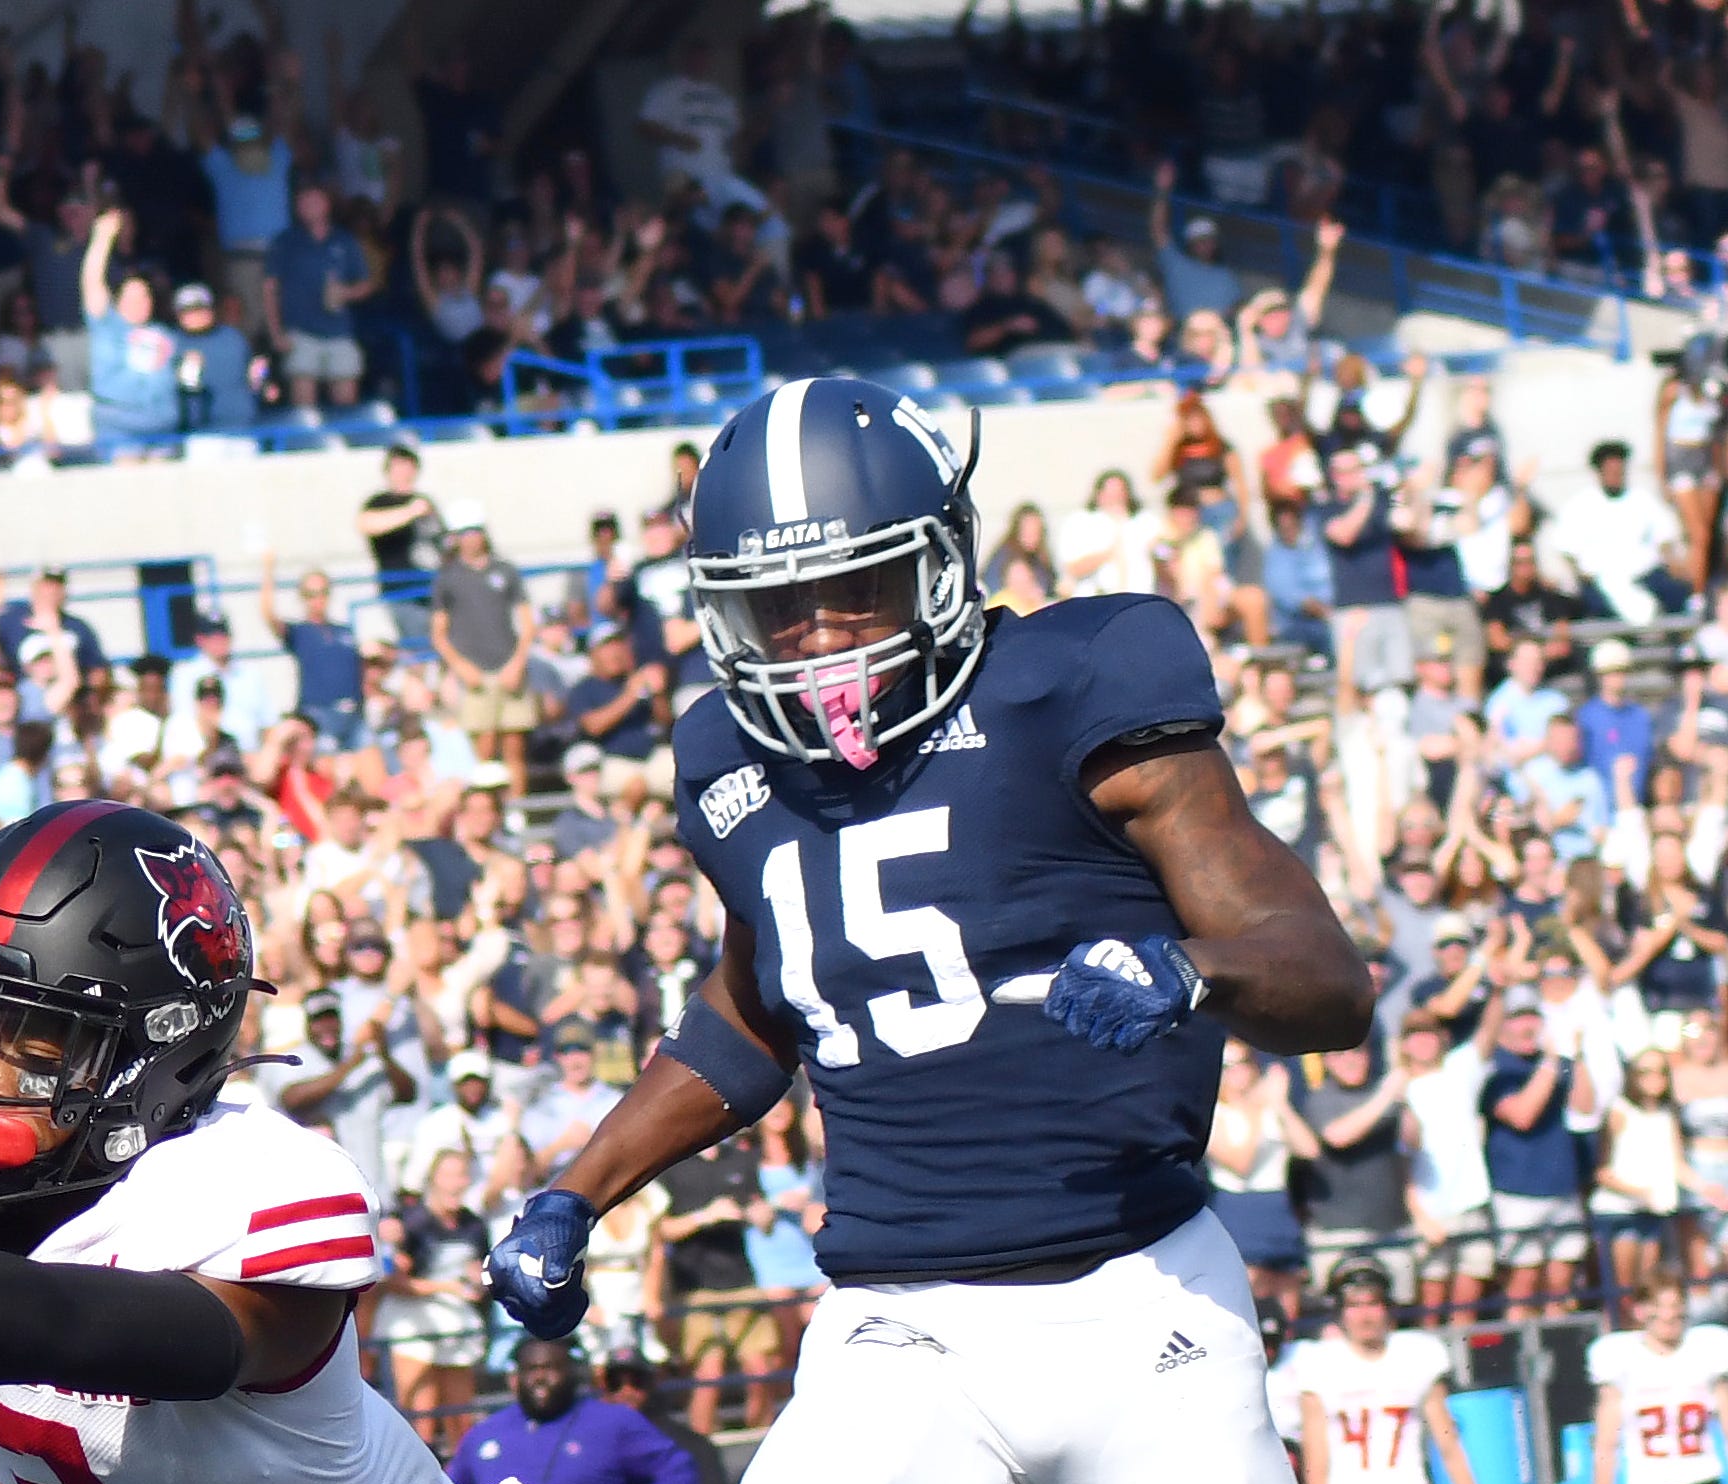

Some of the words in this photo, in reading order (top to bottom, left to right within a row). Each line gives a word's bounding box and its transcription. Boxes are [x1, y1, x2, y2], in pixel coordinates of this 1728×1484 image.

[765, 520, 822, 549] GATA
[761, 806, 988, 1069] 15
[1337, 1405, 1414, 1469] 47
[1637, 1401, 1713, 1459] 28
